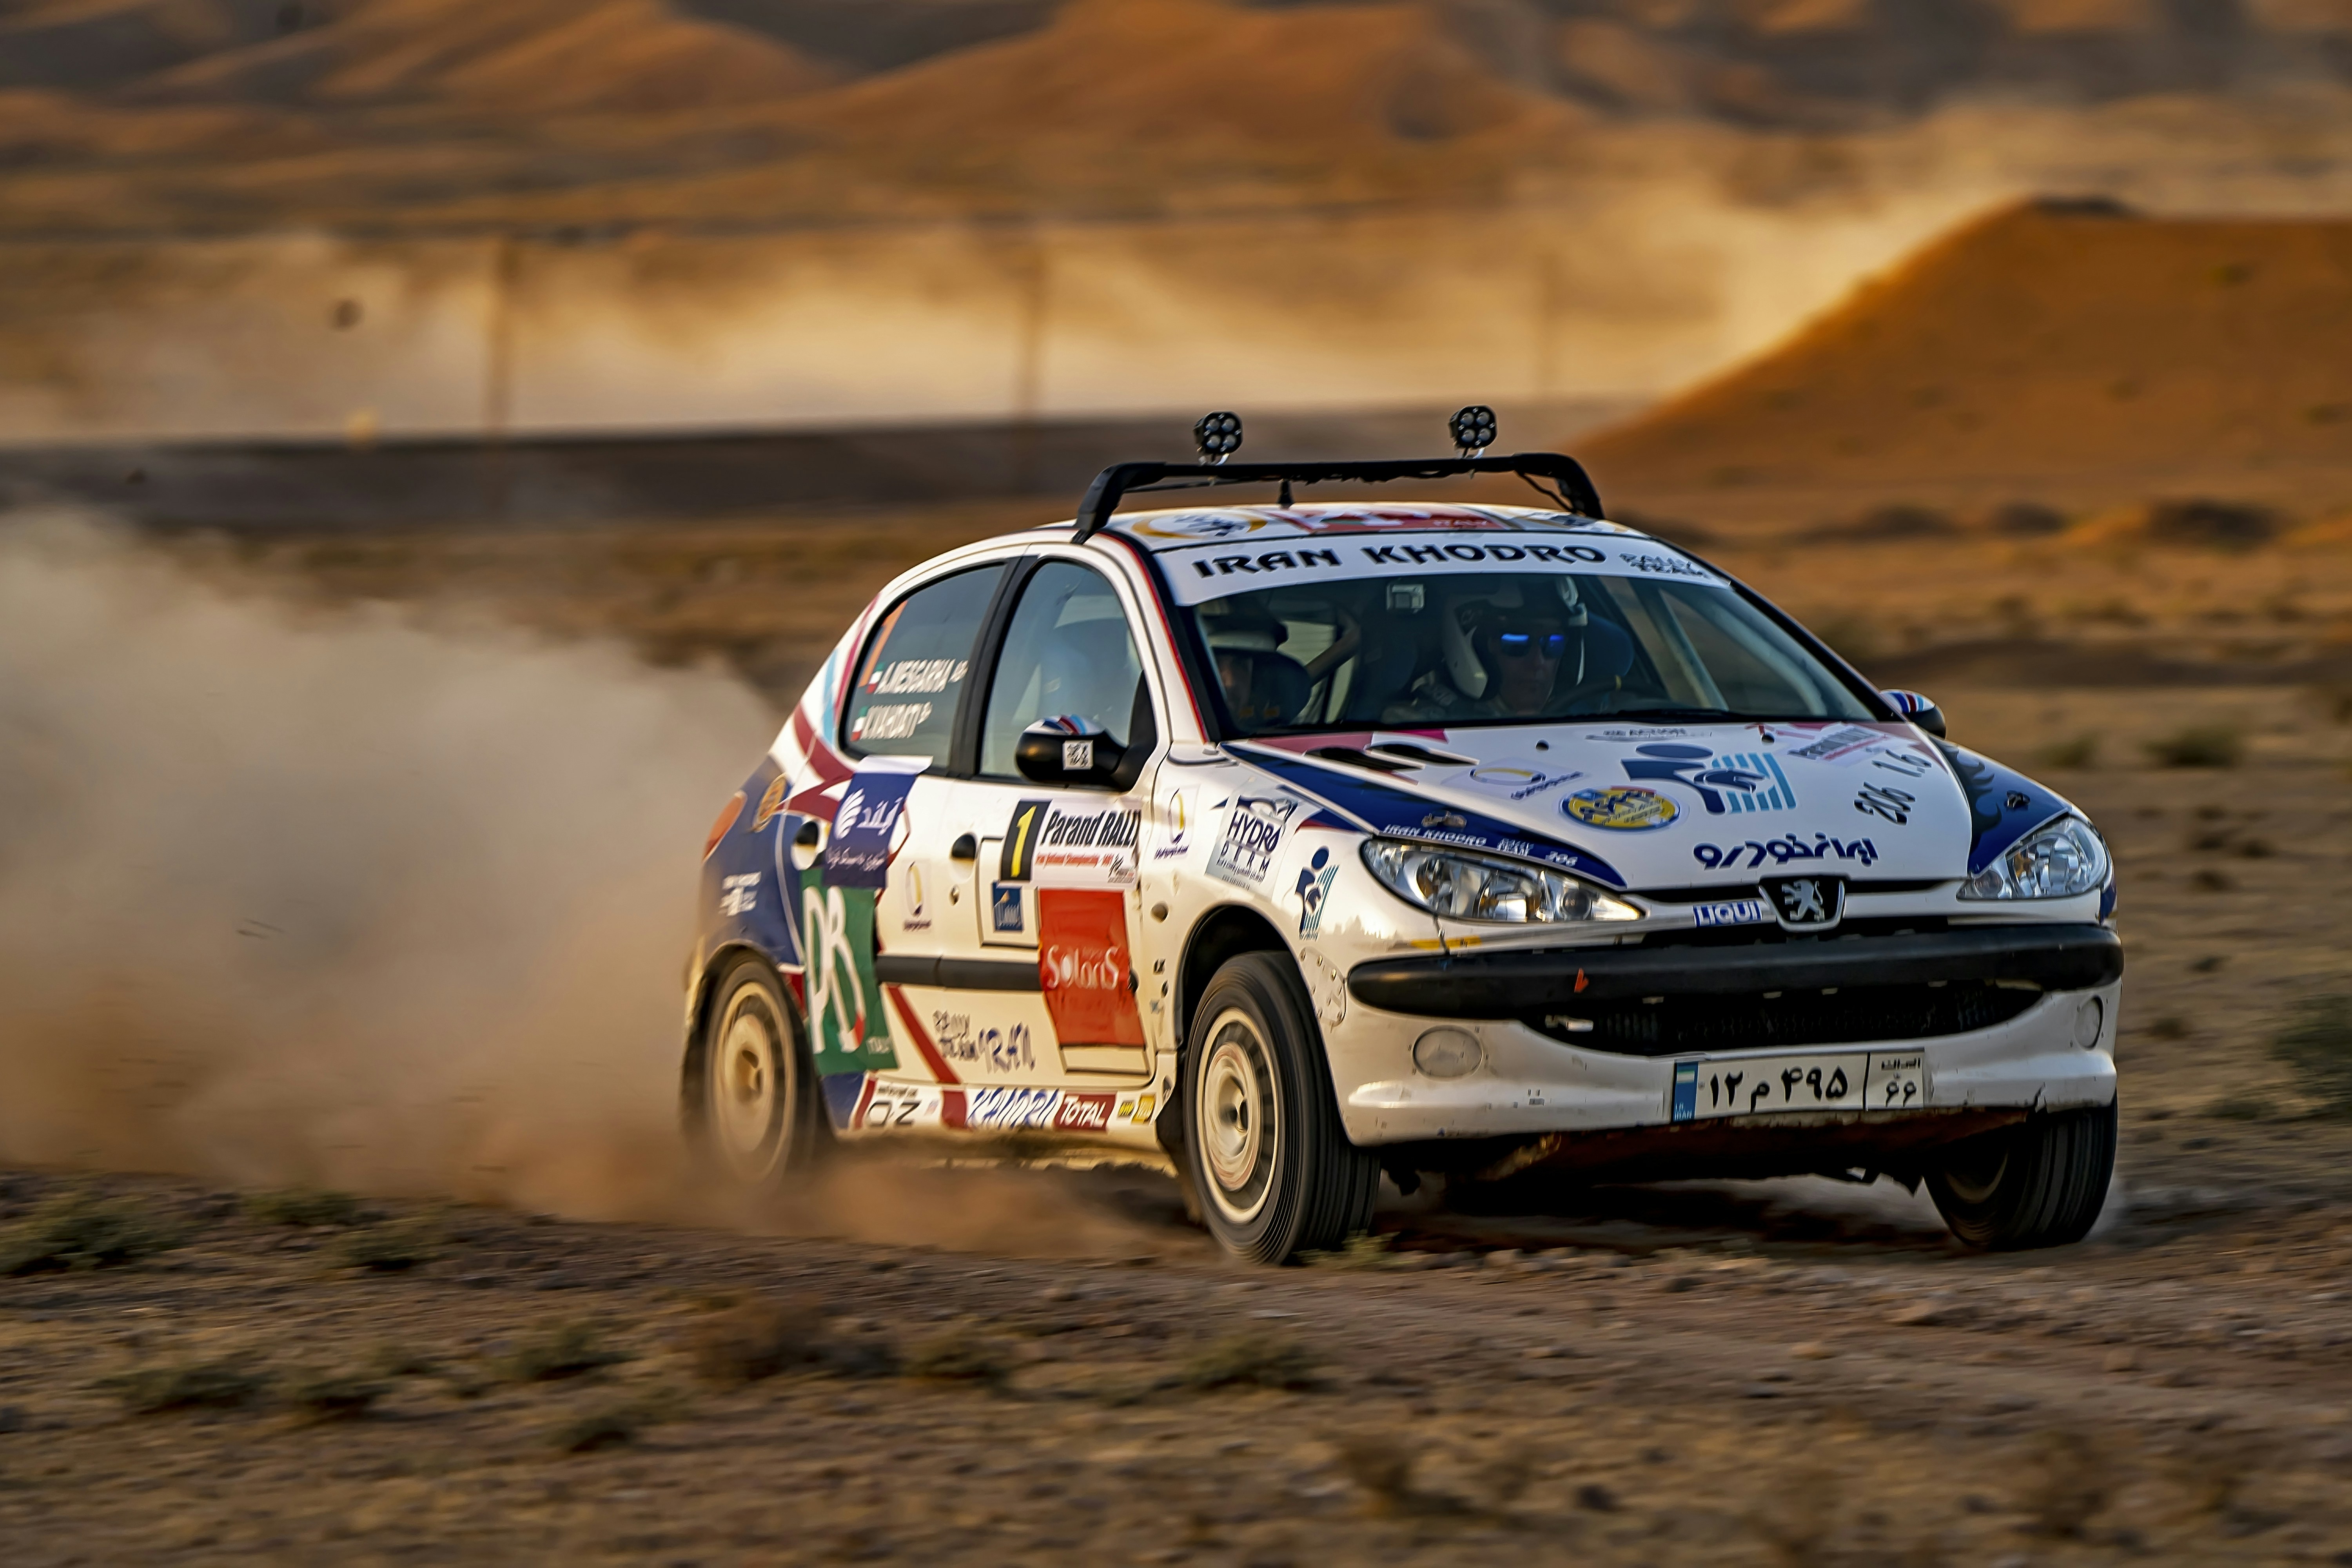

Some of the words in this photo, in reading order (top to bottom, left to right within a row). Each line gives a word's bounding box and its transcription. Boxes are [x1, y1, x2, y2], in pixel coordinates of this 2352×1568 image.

[1192, 548, 1343, 578] IRAN
[1360, 544, 1608, 565] KHODRO
[1871, 748, 1933, 778] 1.6
[1853, 781, 1916, 826] 206
[1011, 805, 1037, 878] 1
[1039, 808, 1106, 847] Parand
[1226, 809, 1283, 855] HYDRO
[1382, 823, 1421, 837] IRAN
[1422, 829, 1487, 847] KHODRO
[1695, 900, 1762, 926] LIQUI
[1884, 1080, 1917, 1107] ۶۶
[1058, 1094, 1106, 1127] TOTAL
[1675, 1109, 1692, 1121] IRAN
